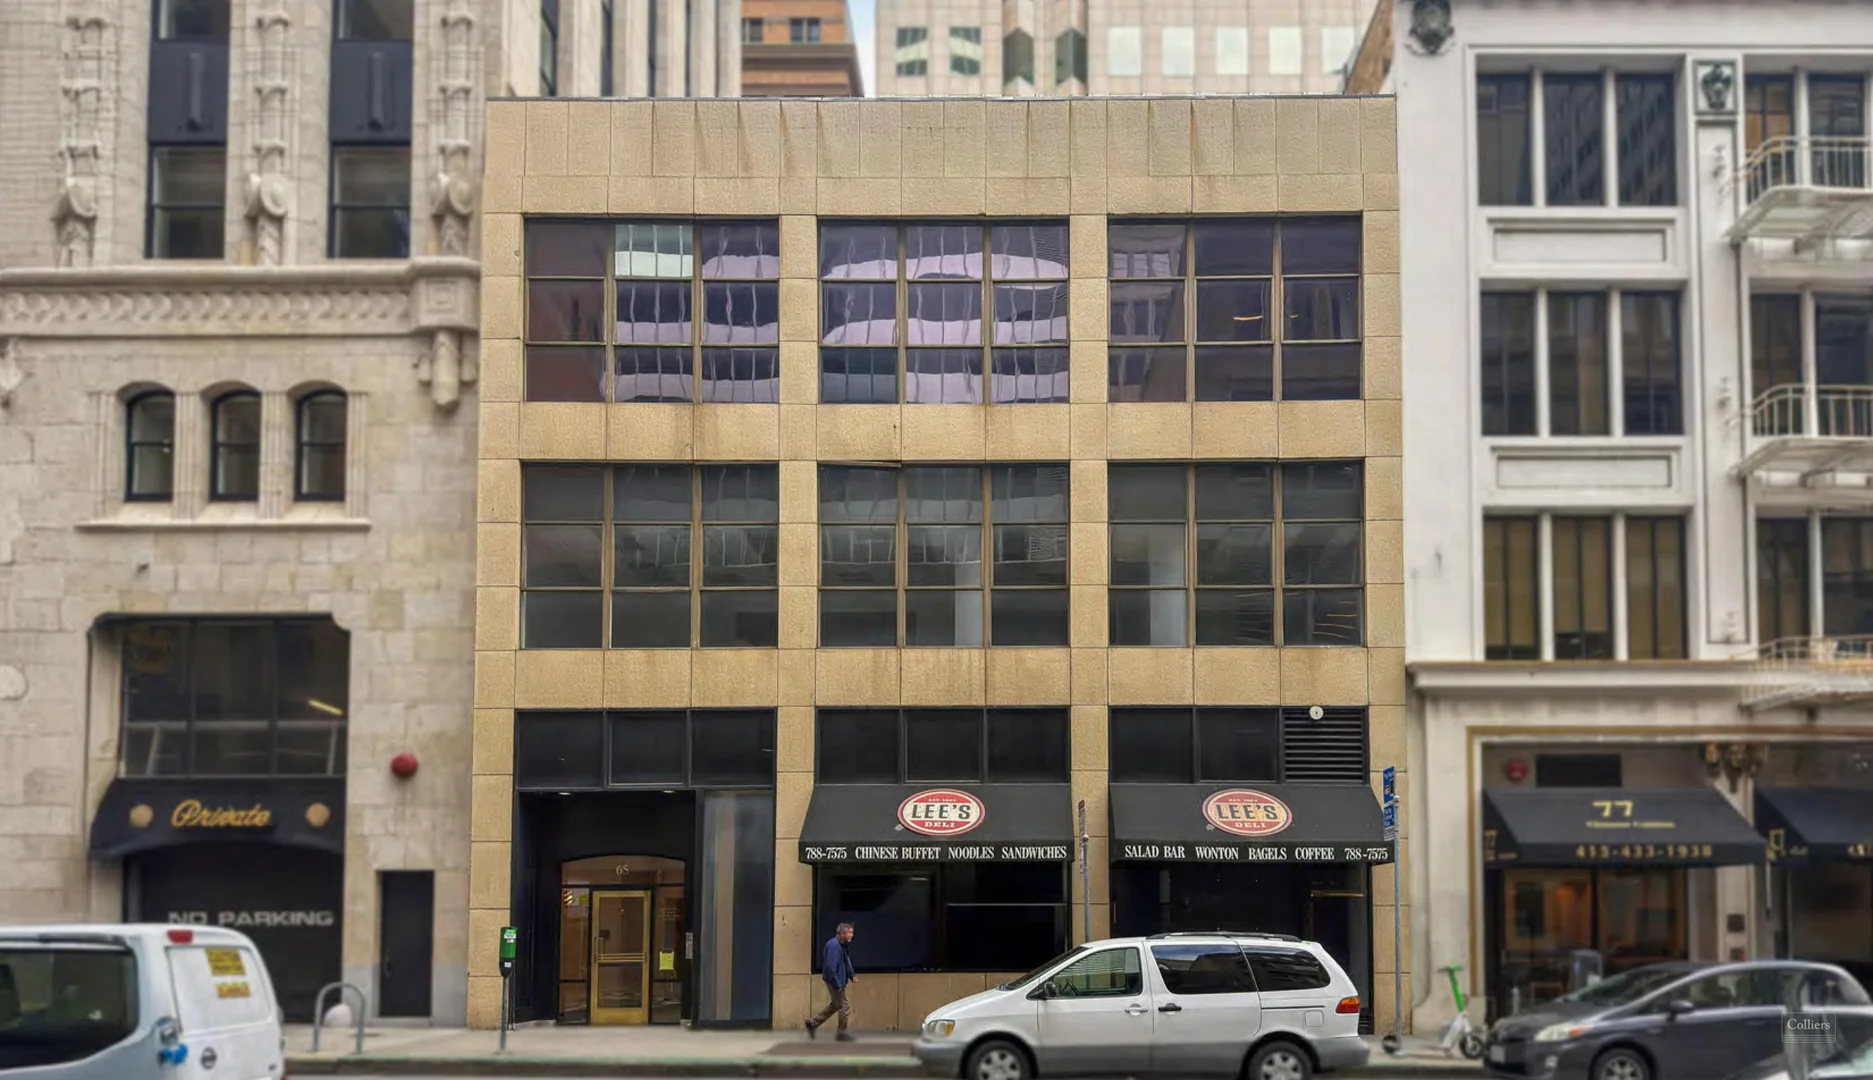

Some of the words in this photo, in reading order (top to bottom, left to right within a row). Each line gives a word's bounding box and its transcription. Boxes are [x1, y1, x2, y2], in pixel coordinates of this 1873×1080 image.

[171, 799, 272, 828] Private
[911, 804, 971, 820] LEE'S
[1215, 804, 1279, 820] LEE'S
[1592, 800, 1633, 817] 77
[1235, 821, 1266, 829] DELI
[805, 846, 848, 860] 788-7575
[854, 845, 899, 859] CHINESE
[901, 846, 942, 860] BUFFET
[948, 845, 995, 860] NOODLES
[1001, 845, 1068, 860] SANDWICHES
[1124, 844, 1160, 859] SALAD
[1163, 845, 1187, 859] BAR
[1194, 846, 1240, 860] WONTON
[1248, 846, 1288, 861] BAGELS
[1294, 846, 1336, 860] COFFEE
[1343, 847, 1389, 861] 788-7575
[168, 911, 208, 925] NO
[219, 911, 334, 926] PARKING
